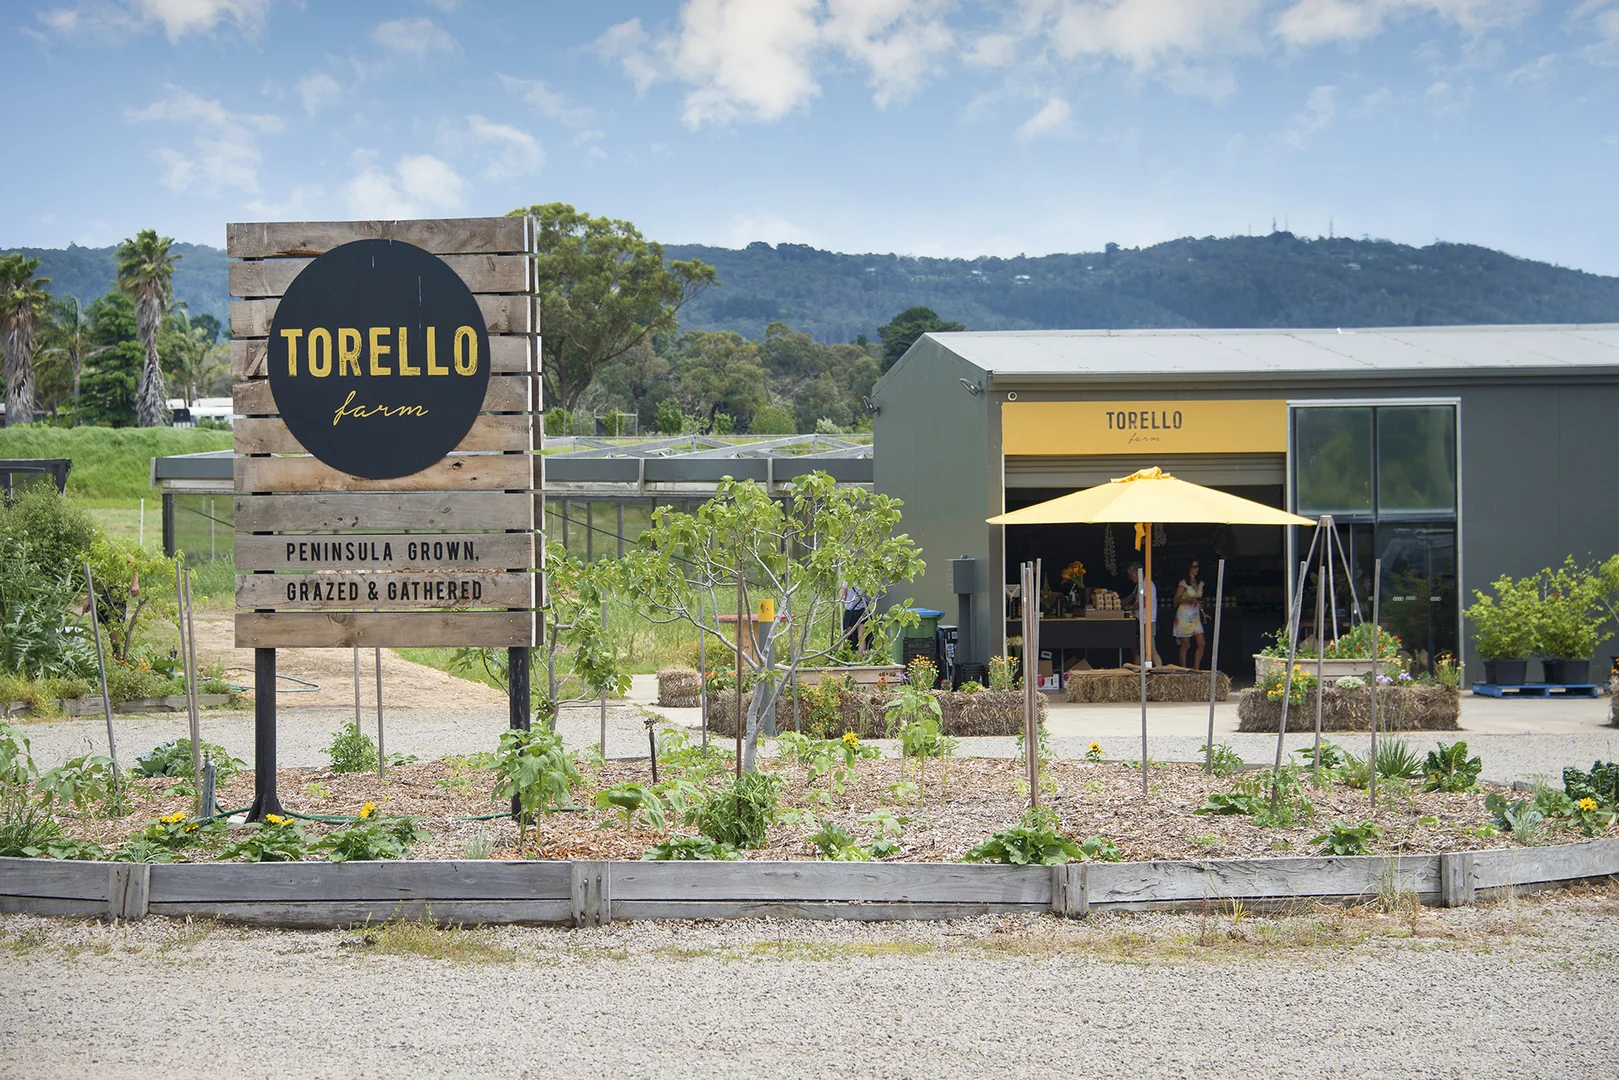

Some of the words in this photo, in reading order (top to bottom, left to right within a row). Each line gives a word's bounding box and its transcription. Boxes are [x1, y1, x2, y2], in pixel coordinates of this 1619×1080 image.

[280, 325, 479, 378] TORELLO
[333, 389, 428, 426] farm
[1105, 410, 1183, 430] TORELLO
[286, 542, 393, 562] PENINSULA
[408, 541, 479, 562] GROWN,
[286, 582, 359, 601] GRAZED
[367, 582, 379, 601] &
[387, 580, 482, 602] GATHERED
